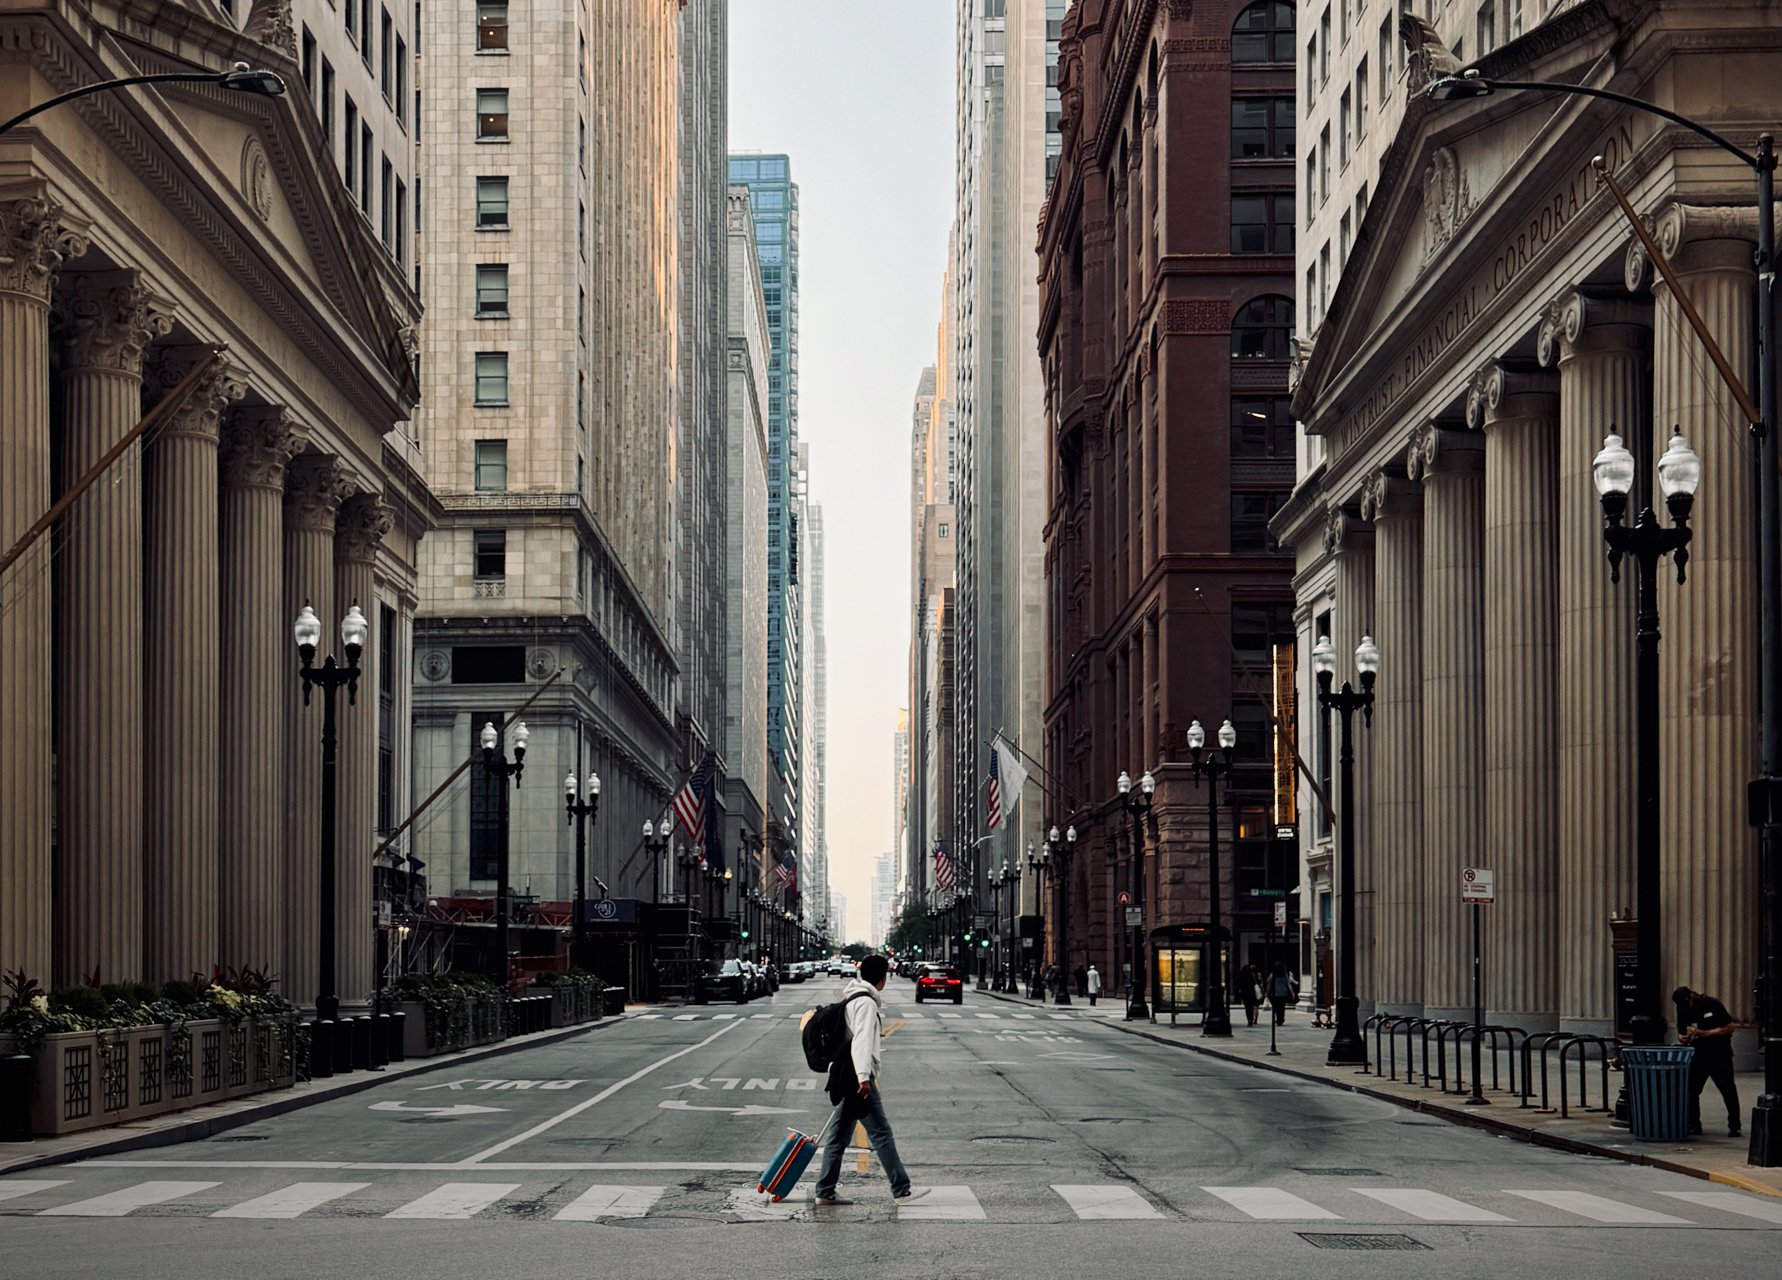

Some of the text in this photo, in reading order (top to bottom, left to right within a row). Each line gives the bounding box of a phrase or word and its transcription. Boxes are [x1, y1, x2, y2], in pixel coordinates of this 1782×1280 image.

[1340, 373, 1395, 450] WINTRUST
[1404, 285, 1482, 387] FINANCIAL
[414, 1079, 589, 1090] ONLY
[661, 1077, 818, 1090] ONLY
